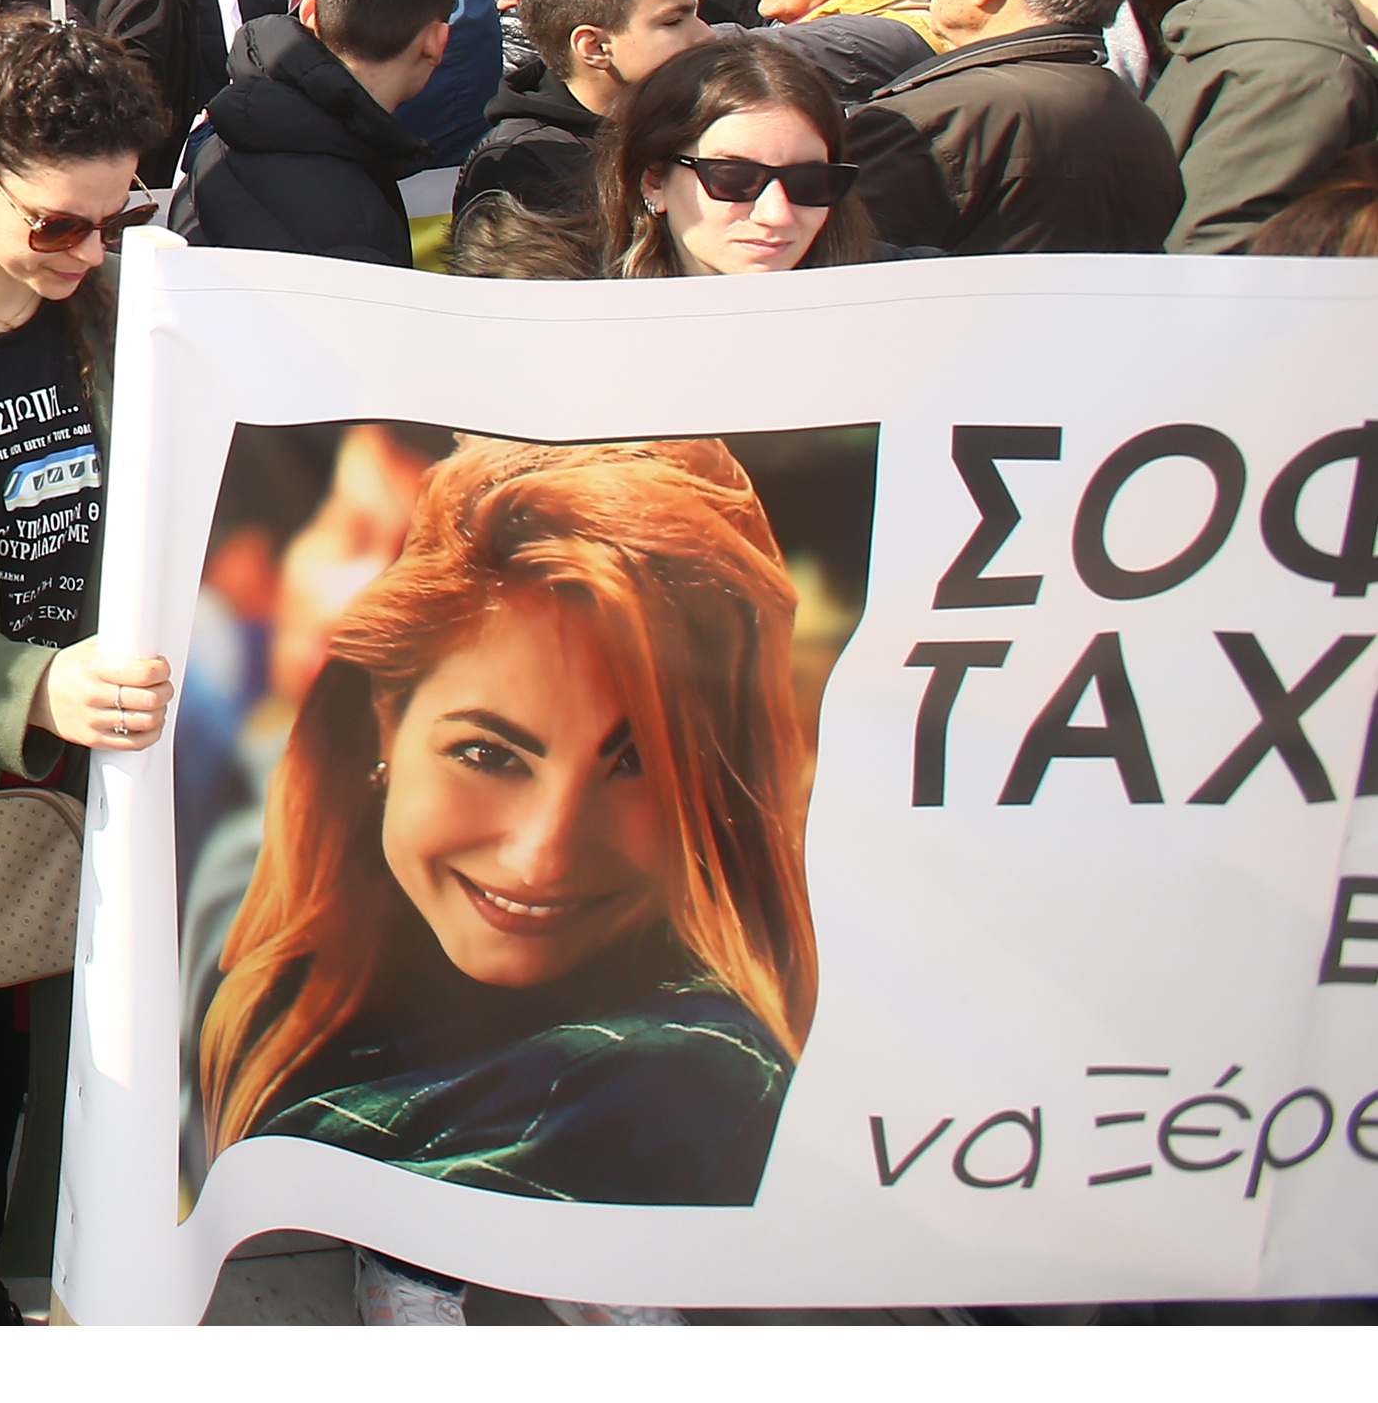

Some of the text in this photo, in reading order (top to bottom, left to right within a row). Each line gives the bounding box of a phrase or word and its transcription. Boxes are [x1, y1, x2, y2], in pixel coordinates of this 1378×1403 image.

[59, 575, 85, 591] 202
[902, 629, 1378, 808] ΤΑΧ
[868, 1104, 1043, 1190] να
